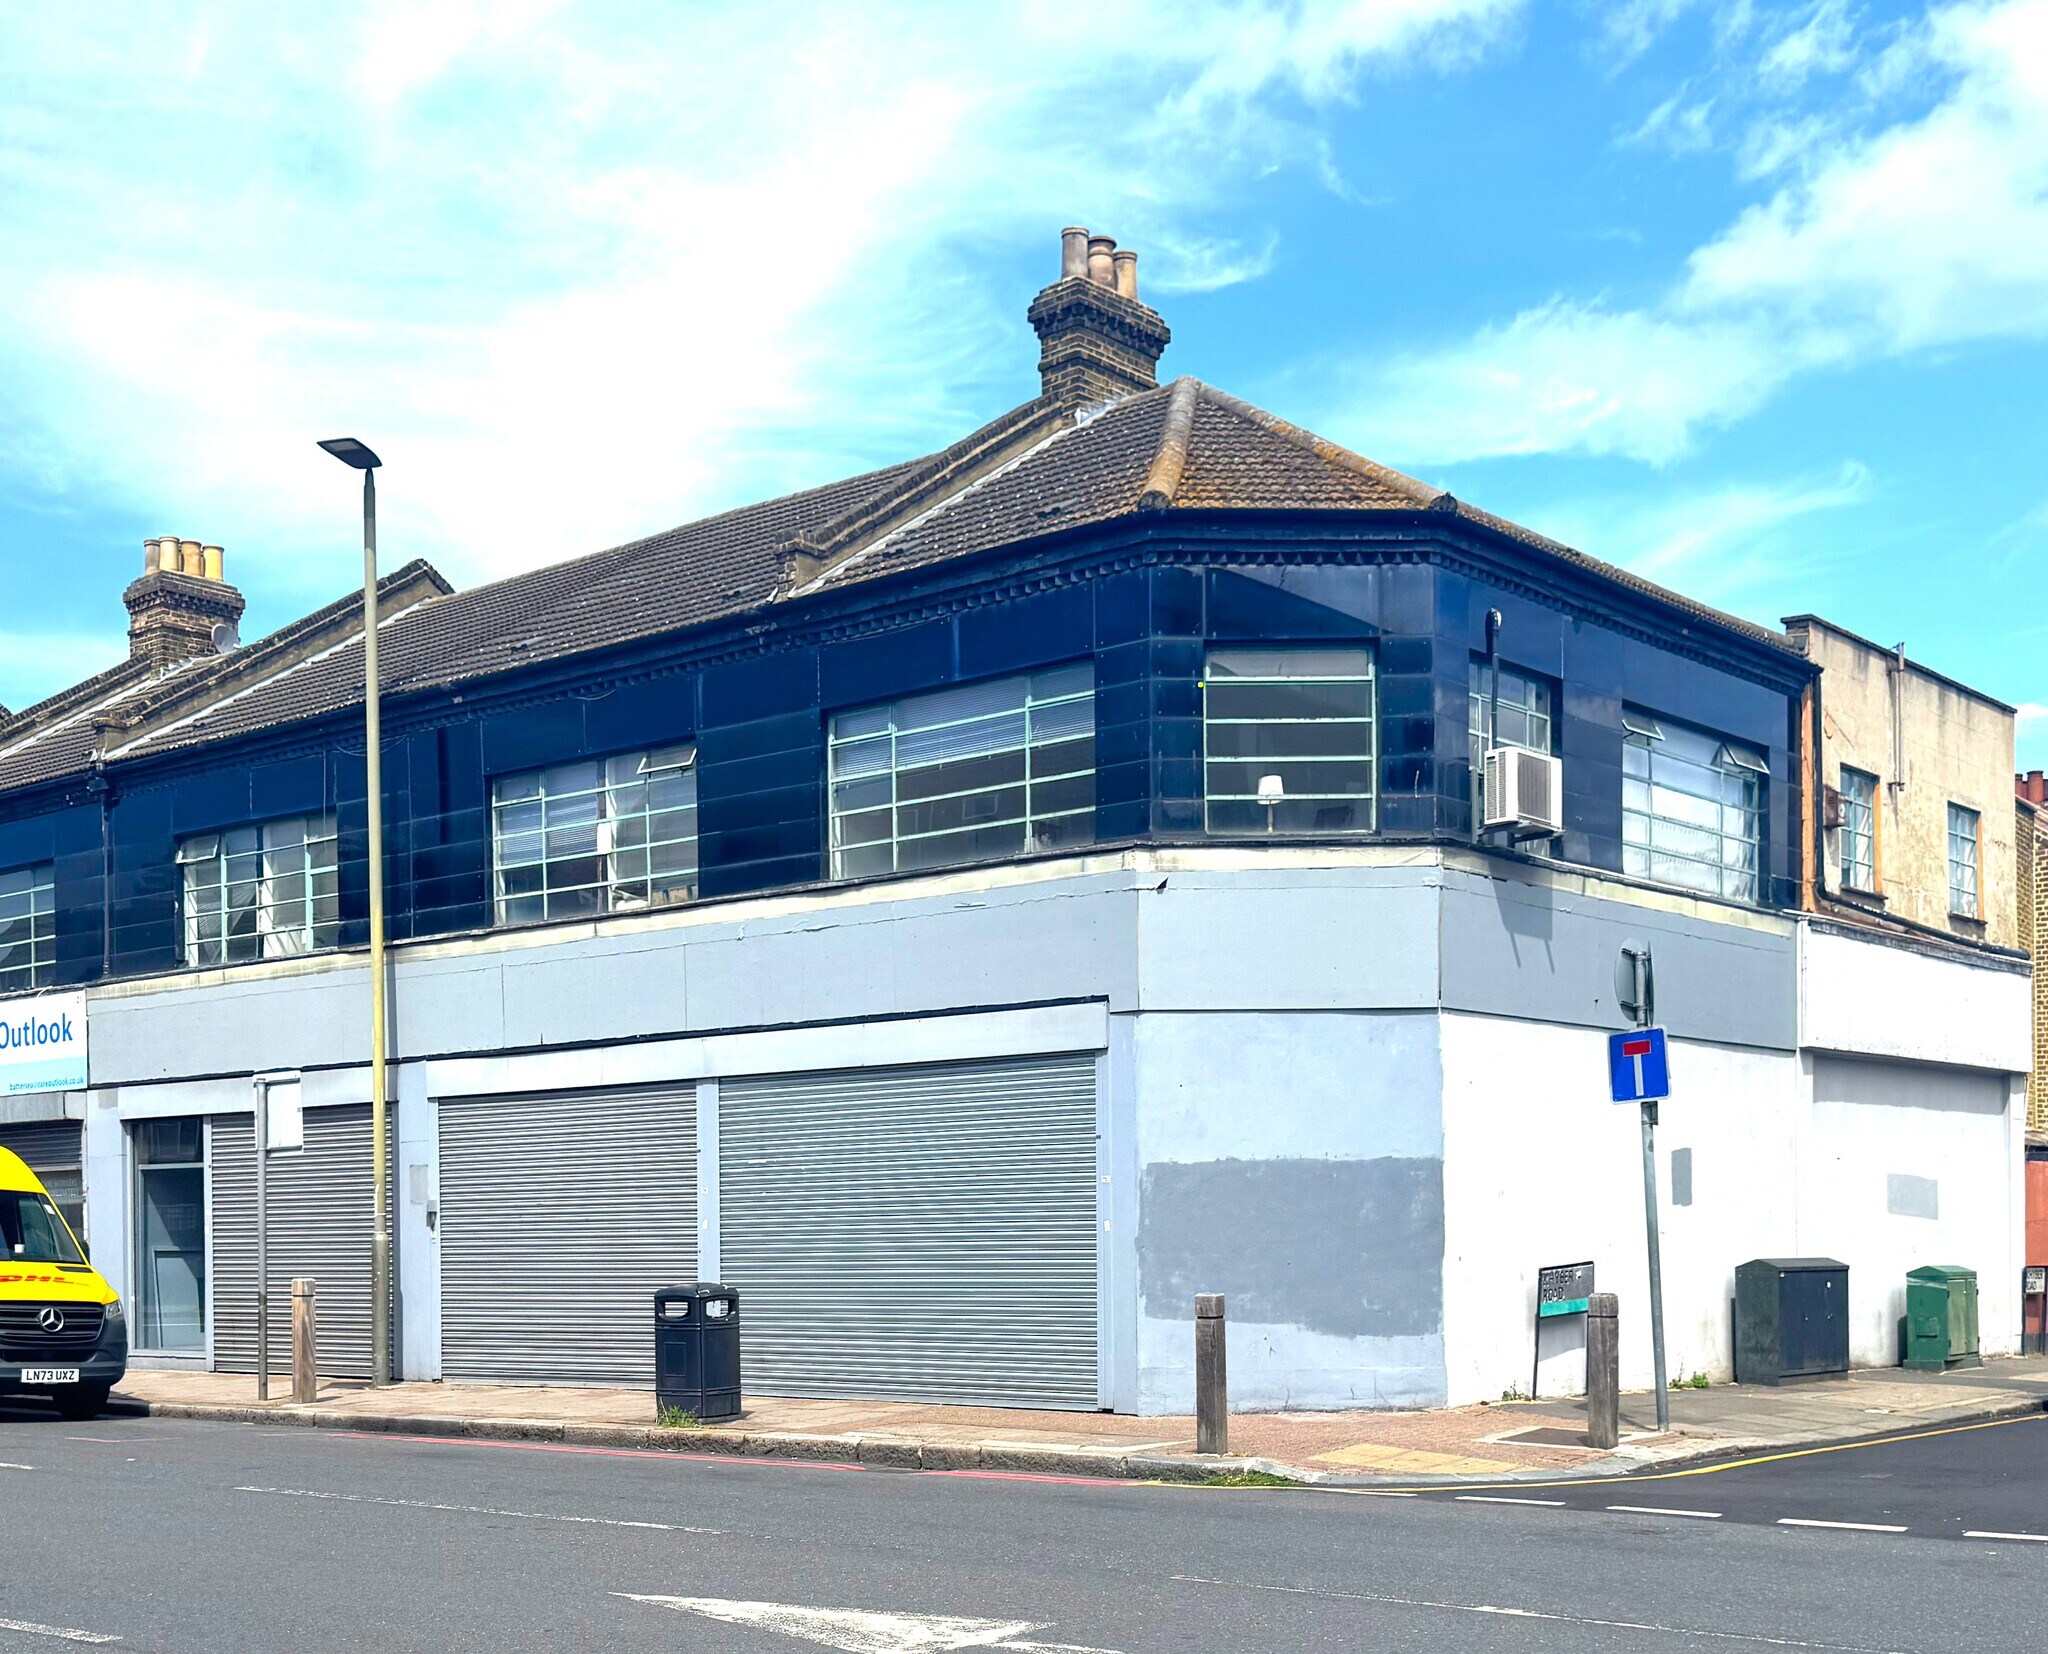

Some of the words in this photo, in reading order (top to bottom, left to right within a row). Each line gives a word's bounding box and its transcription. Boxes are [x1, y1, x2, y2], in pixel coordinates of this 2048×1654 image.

[0, 1013, 73, 1050] Outlook
[0, 1275, 74, 1284] DHL
[1543, 1287, 1564, 1302] ROAD
[26, 1370, 53, 1381] LN73
[55, 1370, 75, 1381] UXZ
